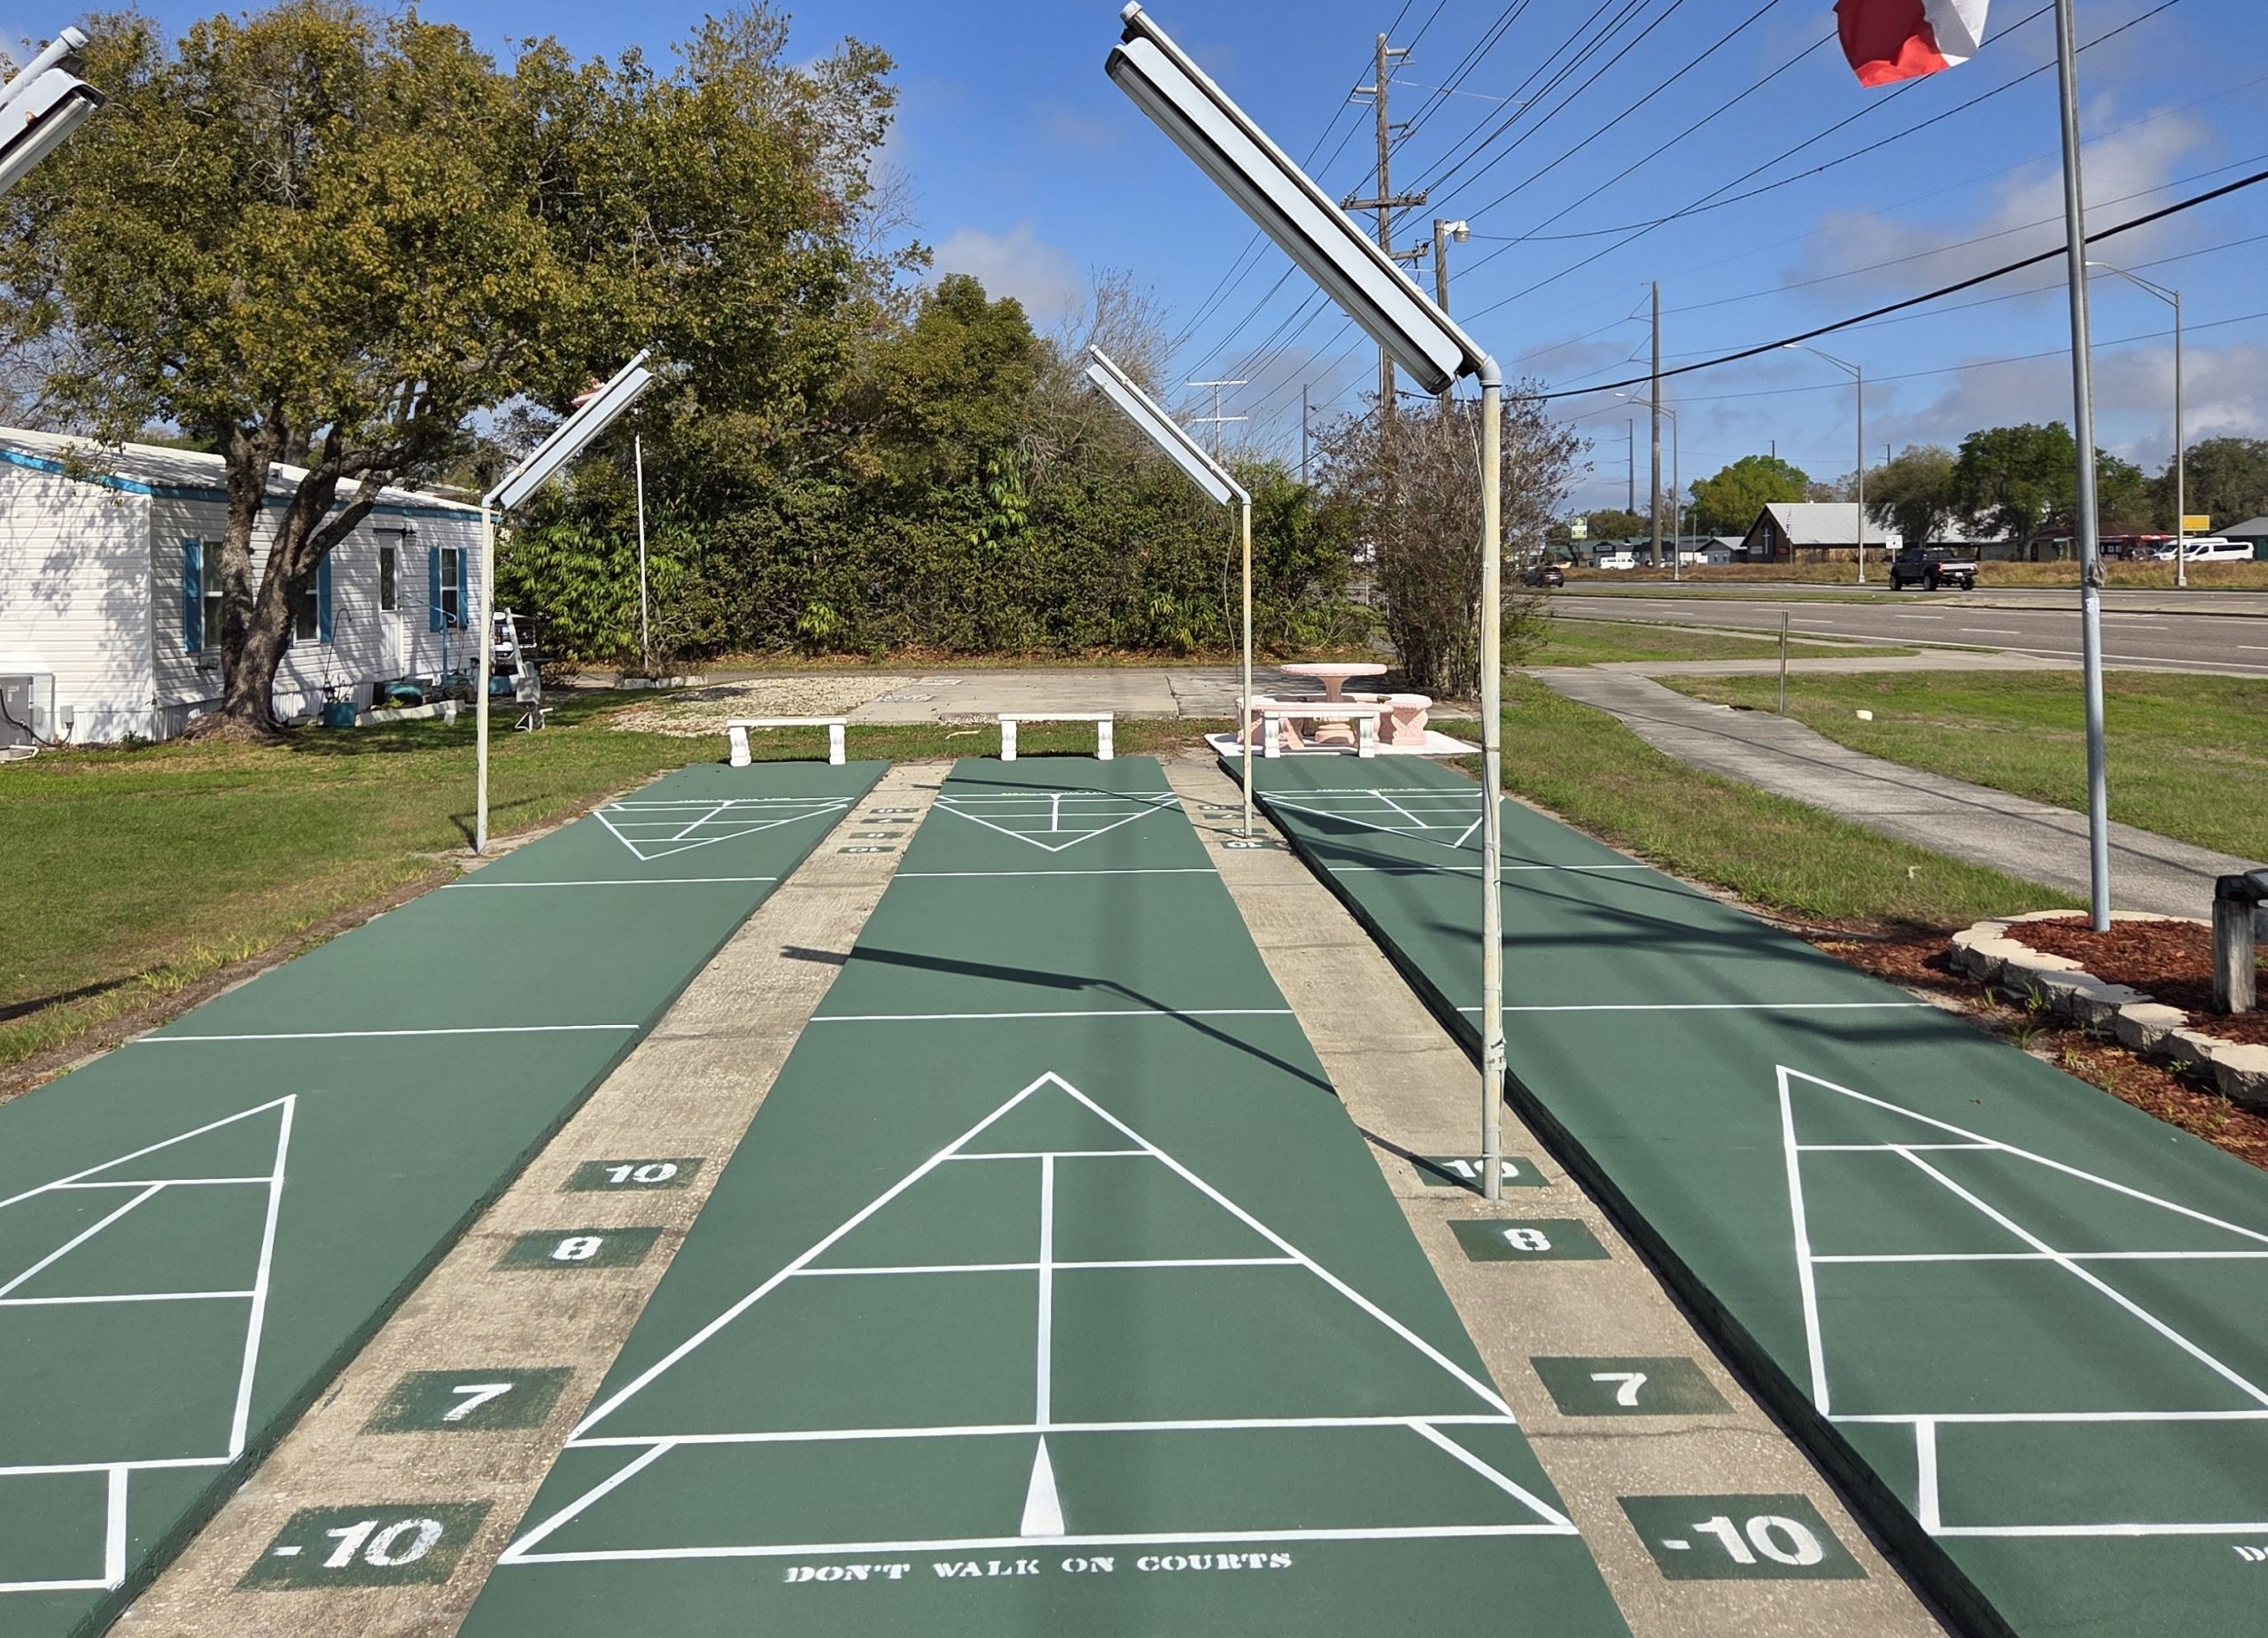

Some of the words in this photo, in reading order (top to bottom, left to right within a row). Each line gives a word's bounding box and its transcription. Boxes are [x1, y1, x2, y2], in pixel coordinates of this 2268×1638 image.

[605, 1163, 678, 1184] 10
[552, 1236, 604, 1261] 8
[1503, 1228, 1552, 1251] 8
[442, 1383, 513, 1422] 7
[1590, 1372, 1648, 1406] 7
[1663, 1515, 1824, 1565] -10
[784, 1563, 911, 1583] DON'T
[932, 1559, 1040, 1577] WALK
[1061, 1557, 1115, 1572] ON
[1137, 1552, 1293, 1572] COURTS
